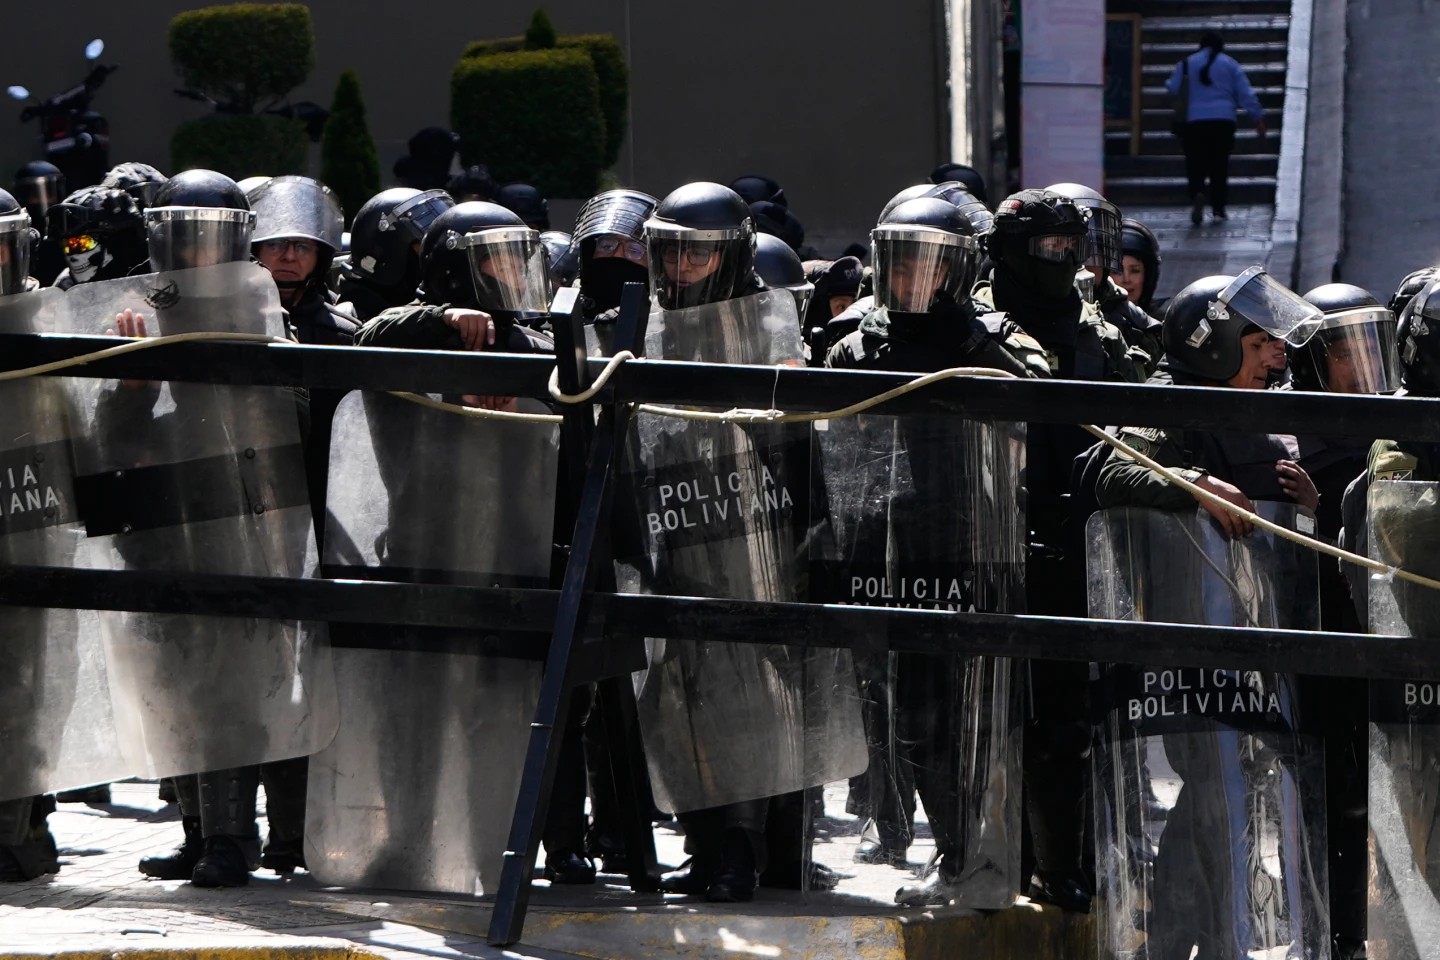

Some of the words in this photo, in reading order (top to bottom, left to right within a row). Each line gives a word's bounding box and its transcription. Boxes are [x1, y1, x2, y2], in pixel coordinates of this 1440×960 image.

[659, 465, 775, 507] POLICIA
[646, 486, 794, 534] BOLIVIANA
[851, 576, 962, 600] POLICIA
[1144, 668, 1265, 693] POLICIA
[1128, 691, 1281, 721] BOLIVIANA
